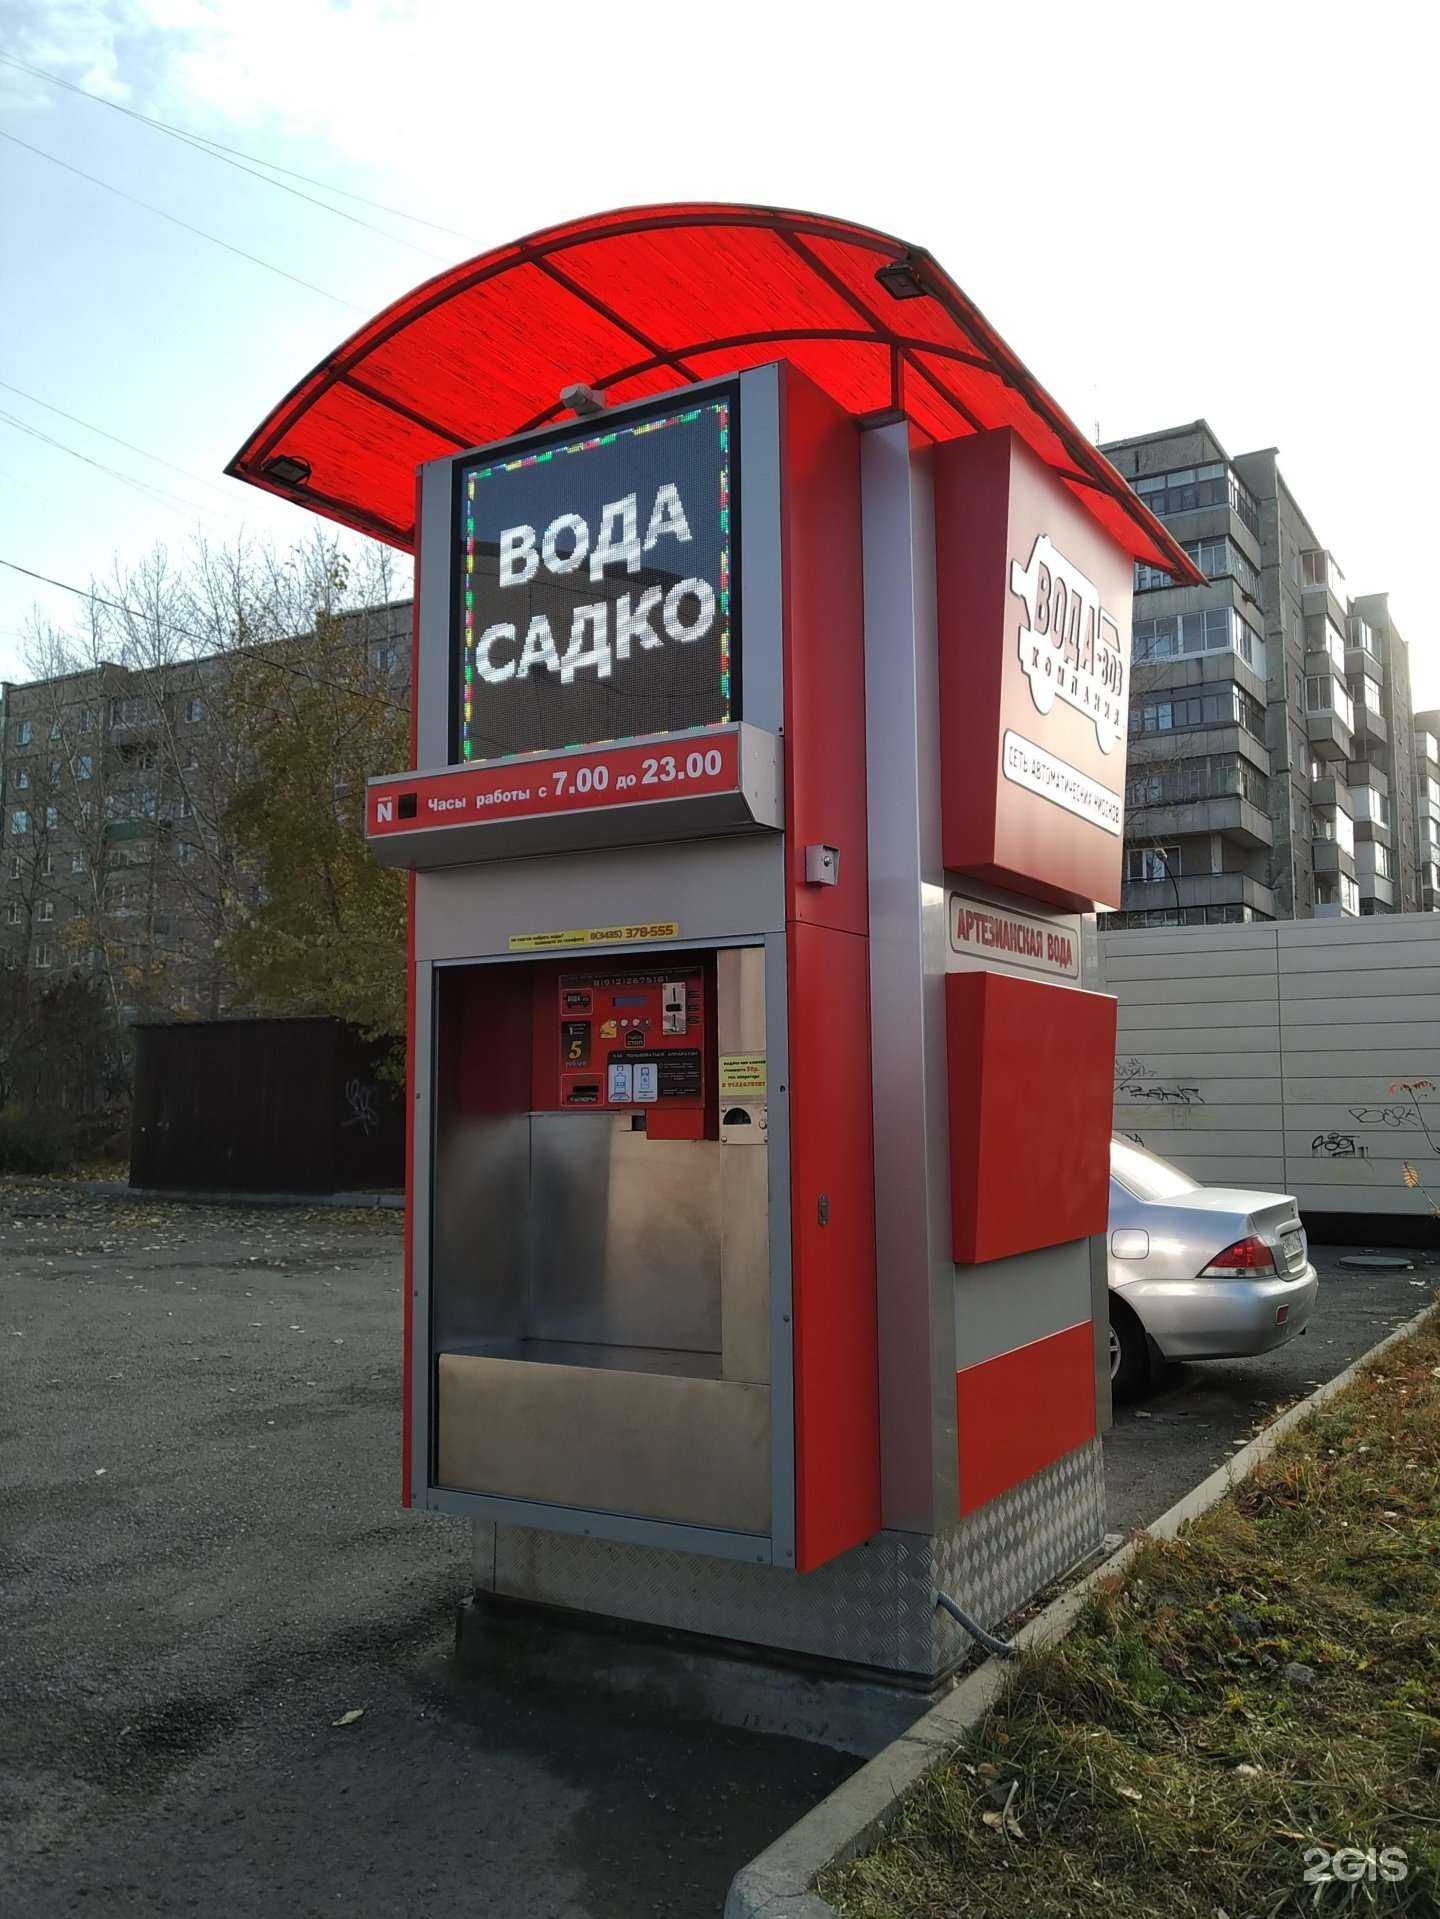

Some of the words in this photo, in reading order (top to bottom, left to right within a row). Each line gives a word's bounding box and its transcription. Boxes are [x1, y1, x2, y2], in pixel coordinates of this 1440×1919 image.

[499, 482, 692, 588] ВОДА
[475, 577, 716, 684] САДКО
[1031, 646, 1120, 727] КОМПАНИЯ
[427, 797, 467, 812] Часы
[476, 787, 531, 808] работы
[538, 786, 548, 798] с
[552, 766, 609, 796] 7.00
[616, 773, 637, 790] до
[641, 750, 723, 785] 23.00
[1008, 746, 1029, 773] СЕТЬ
[625, 924, 674, 938] 378-555
[957, 907, 1043, 960] АРТЕЗИАНСКАЯ
[1047, 932, 1073, 969] ВОДА
[568, 1040, 583, 1059] 5
